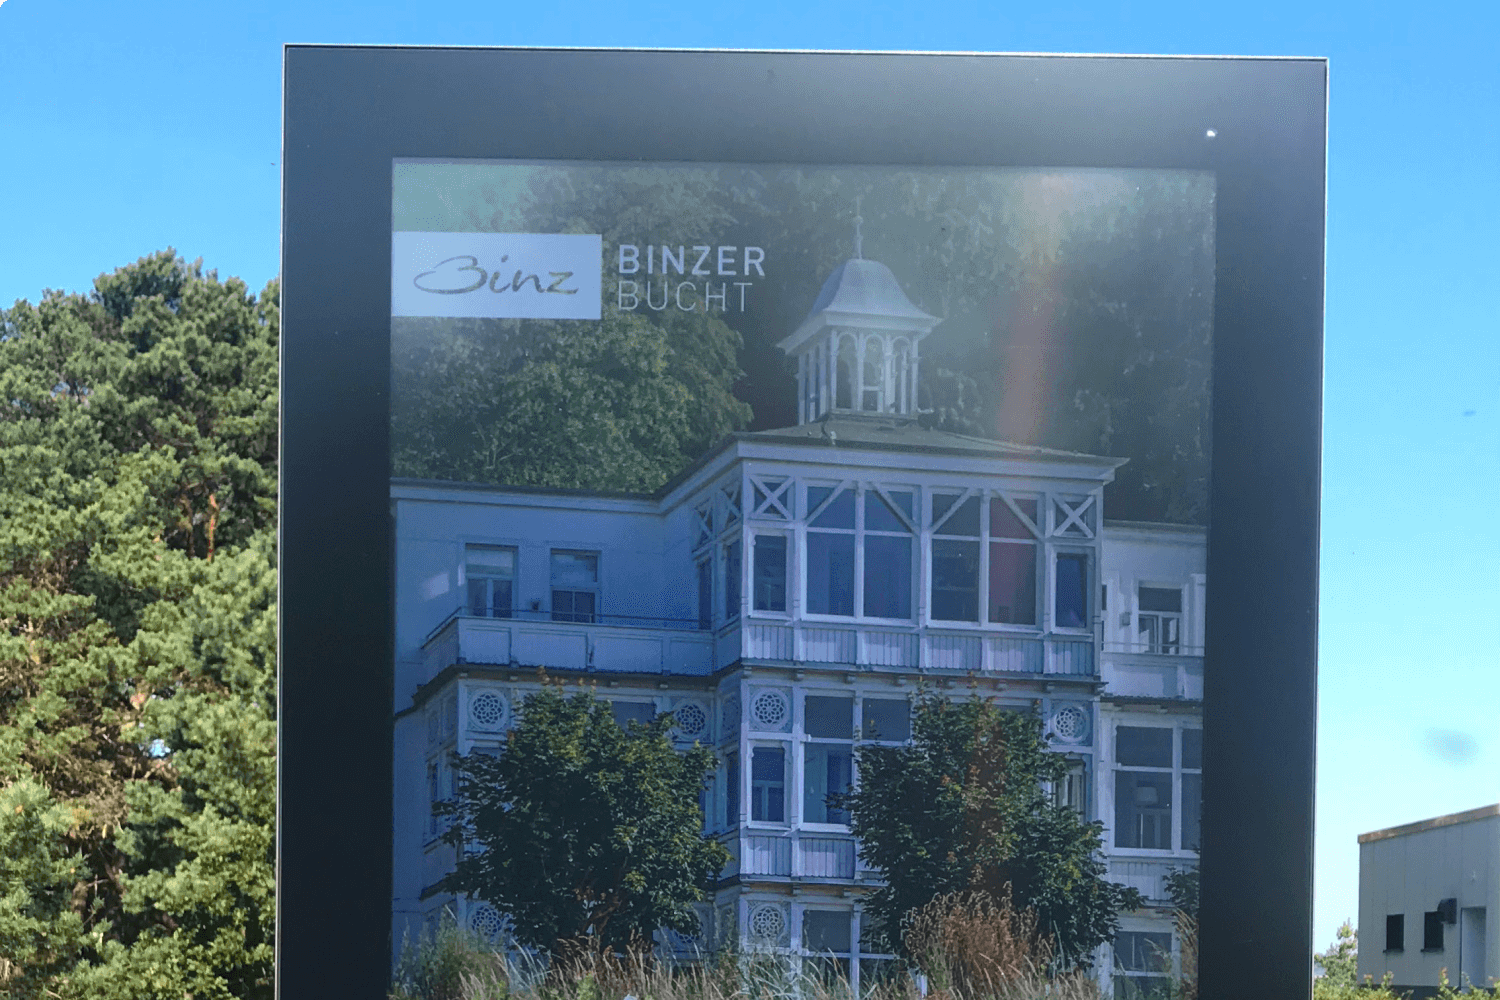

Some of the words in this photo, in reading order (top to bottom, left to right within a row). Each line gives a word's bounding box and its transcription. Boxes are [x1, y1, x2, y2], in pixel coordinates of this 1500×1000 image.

[413, 255, 579, 294] Binz
[619, 244, 765, 276] BINZER
[618, 281, 753, 311] BUCHT
